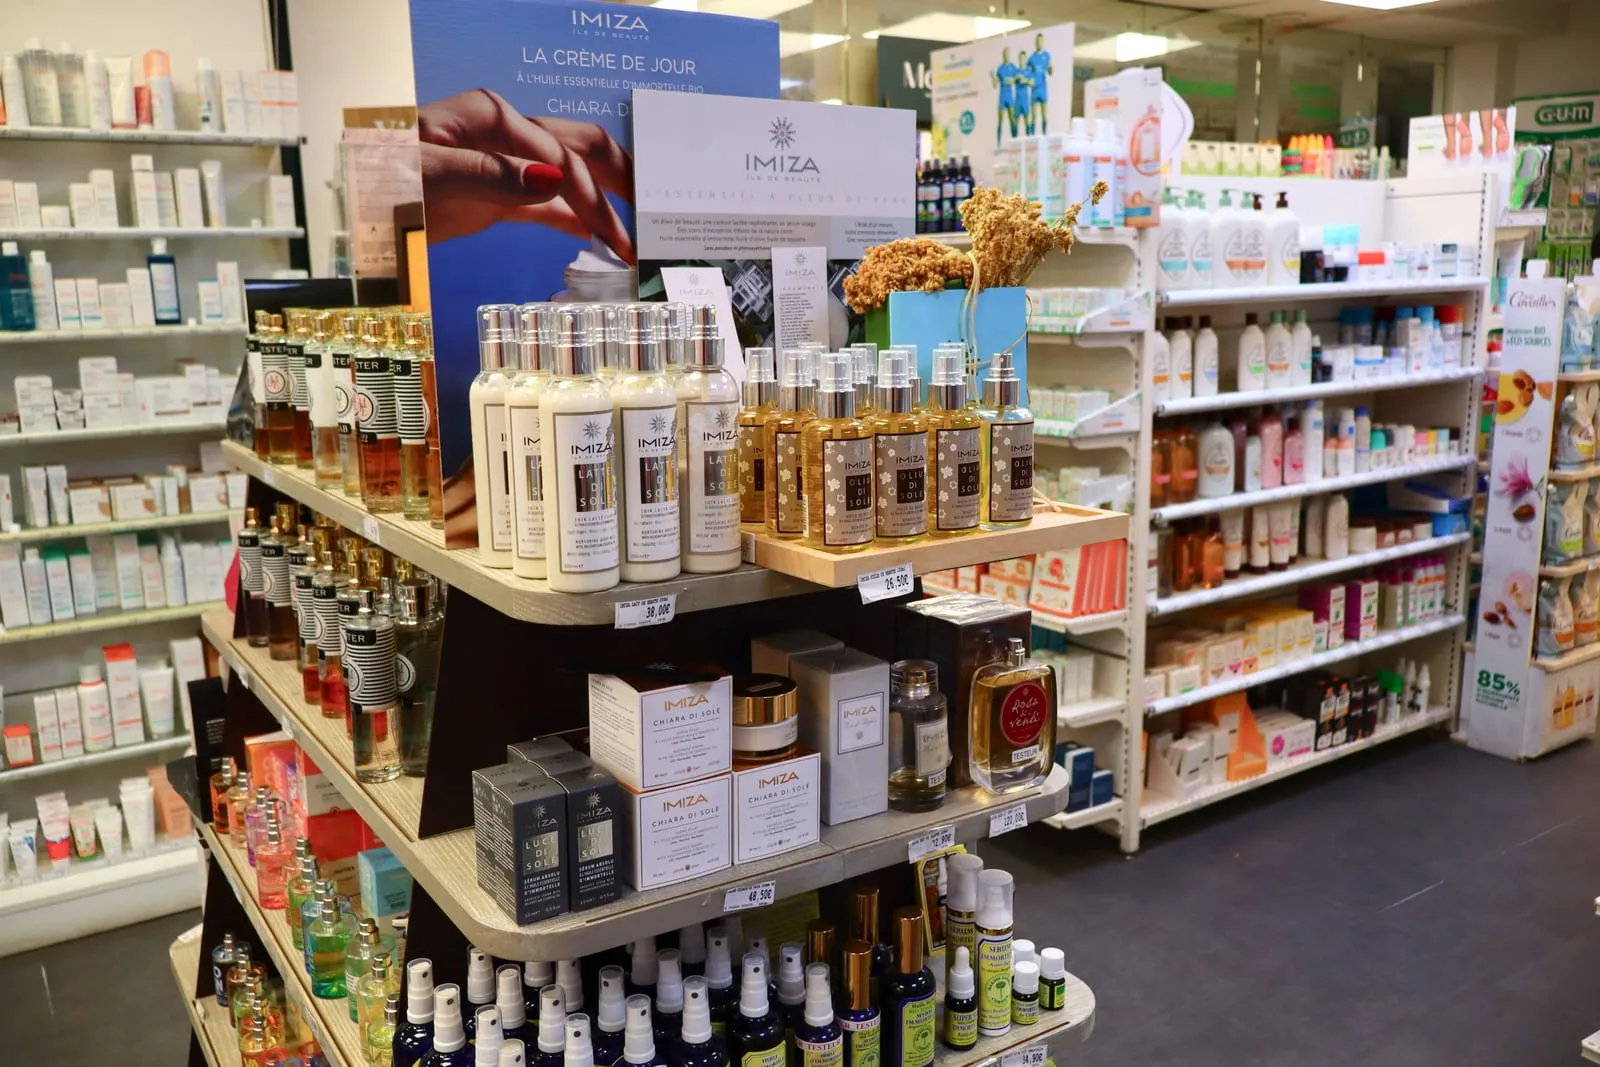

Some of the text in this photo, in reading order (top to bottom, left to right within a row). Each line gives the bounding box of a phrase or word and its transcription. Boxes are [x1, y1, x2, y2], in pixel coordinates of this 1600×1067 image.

[572, 10, 648, 32] IMIZA
[523, 47, 696, 75] LA CRÈME DE JOUR
[517, 71, 524, 82] À
[527, 74, 561, 86] L'HUILE
[564, 76, 620, 89] ESSENTIELLE
[547, 98, 613, 116] CHIARA
[746, 153, 820, 174] IMIZA
[638, 436, 675, 448] IMIZA
[704, 430, 738, 441] IMIZA
[571, 442, 612, 455] IMIZA
[709, 454, 737, 465] LATTE
[845, 460, 871, 471] IMIZA
[896, 455, 924, 465] IMIZA
[709, 480, 738, 491] SOLE
[909, 481, 917, 489] DI
[885, 574, 909, 590] 26,50€
[646, 603, 670, 619] 38,00€
[1478, 669, 1520, 696] 85%
[665, 694, 709, 712] IMIZA
[654, 715, 685, 727] CHIARA
[702, 708, 720, 717] SOLE
[844, 705, 877, 719] IMIZA
[1013, 748, 1038, 761] TESTEUR
[759, 771, 799, 789] IMIZA
[748, 791, 778, 804] CHIARA
[793, 783, 809, 793] SOLE
[663, 794, 708, 813] IMIZA
[652, 815, 684, 828] CHIARA
[701, 806, 720, 816] SOLE
[932, 833, 951, 848] 72,90€
[536, 849, 547, 858] DI
[526, 856, 558, 871] SOLE
[749, 889, 772, 903] 48,50€
